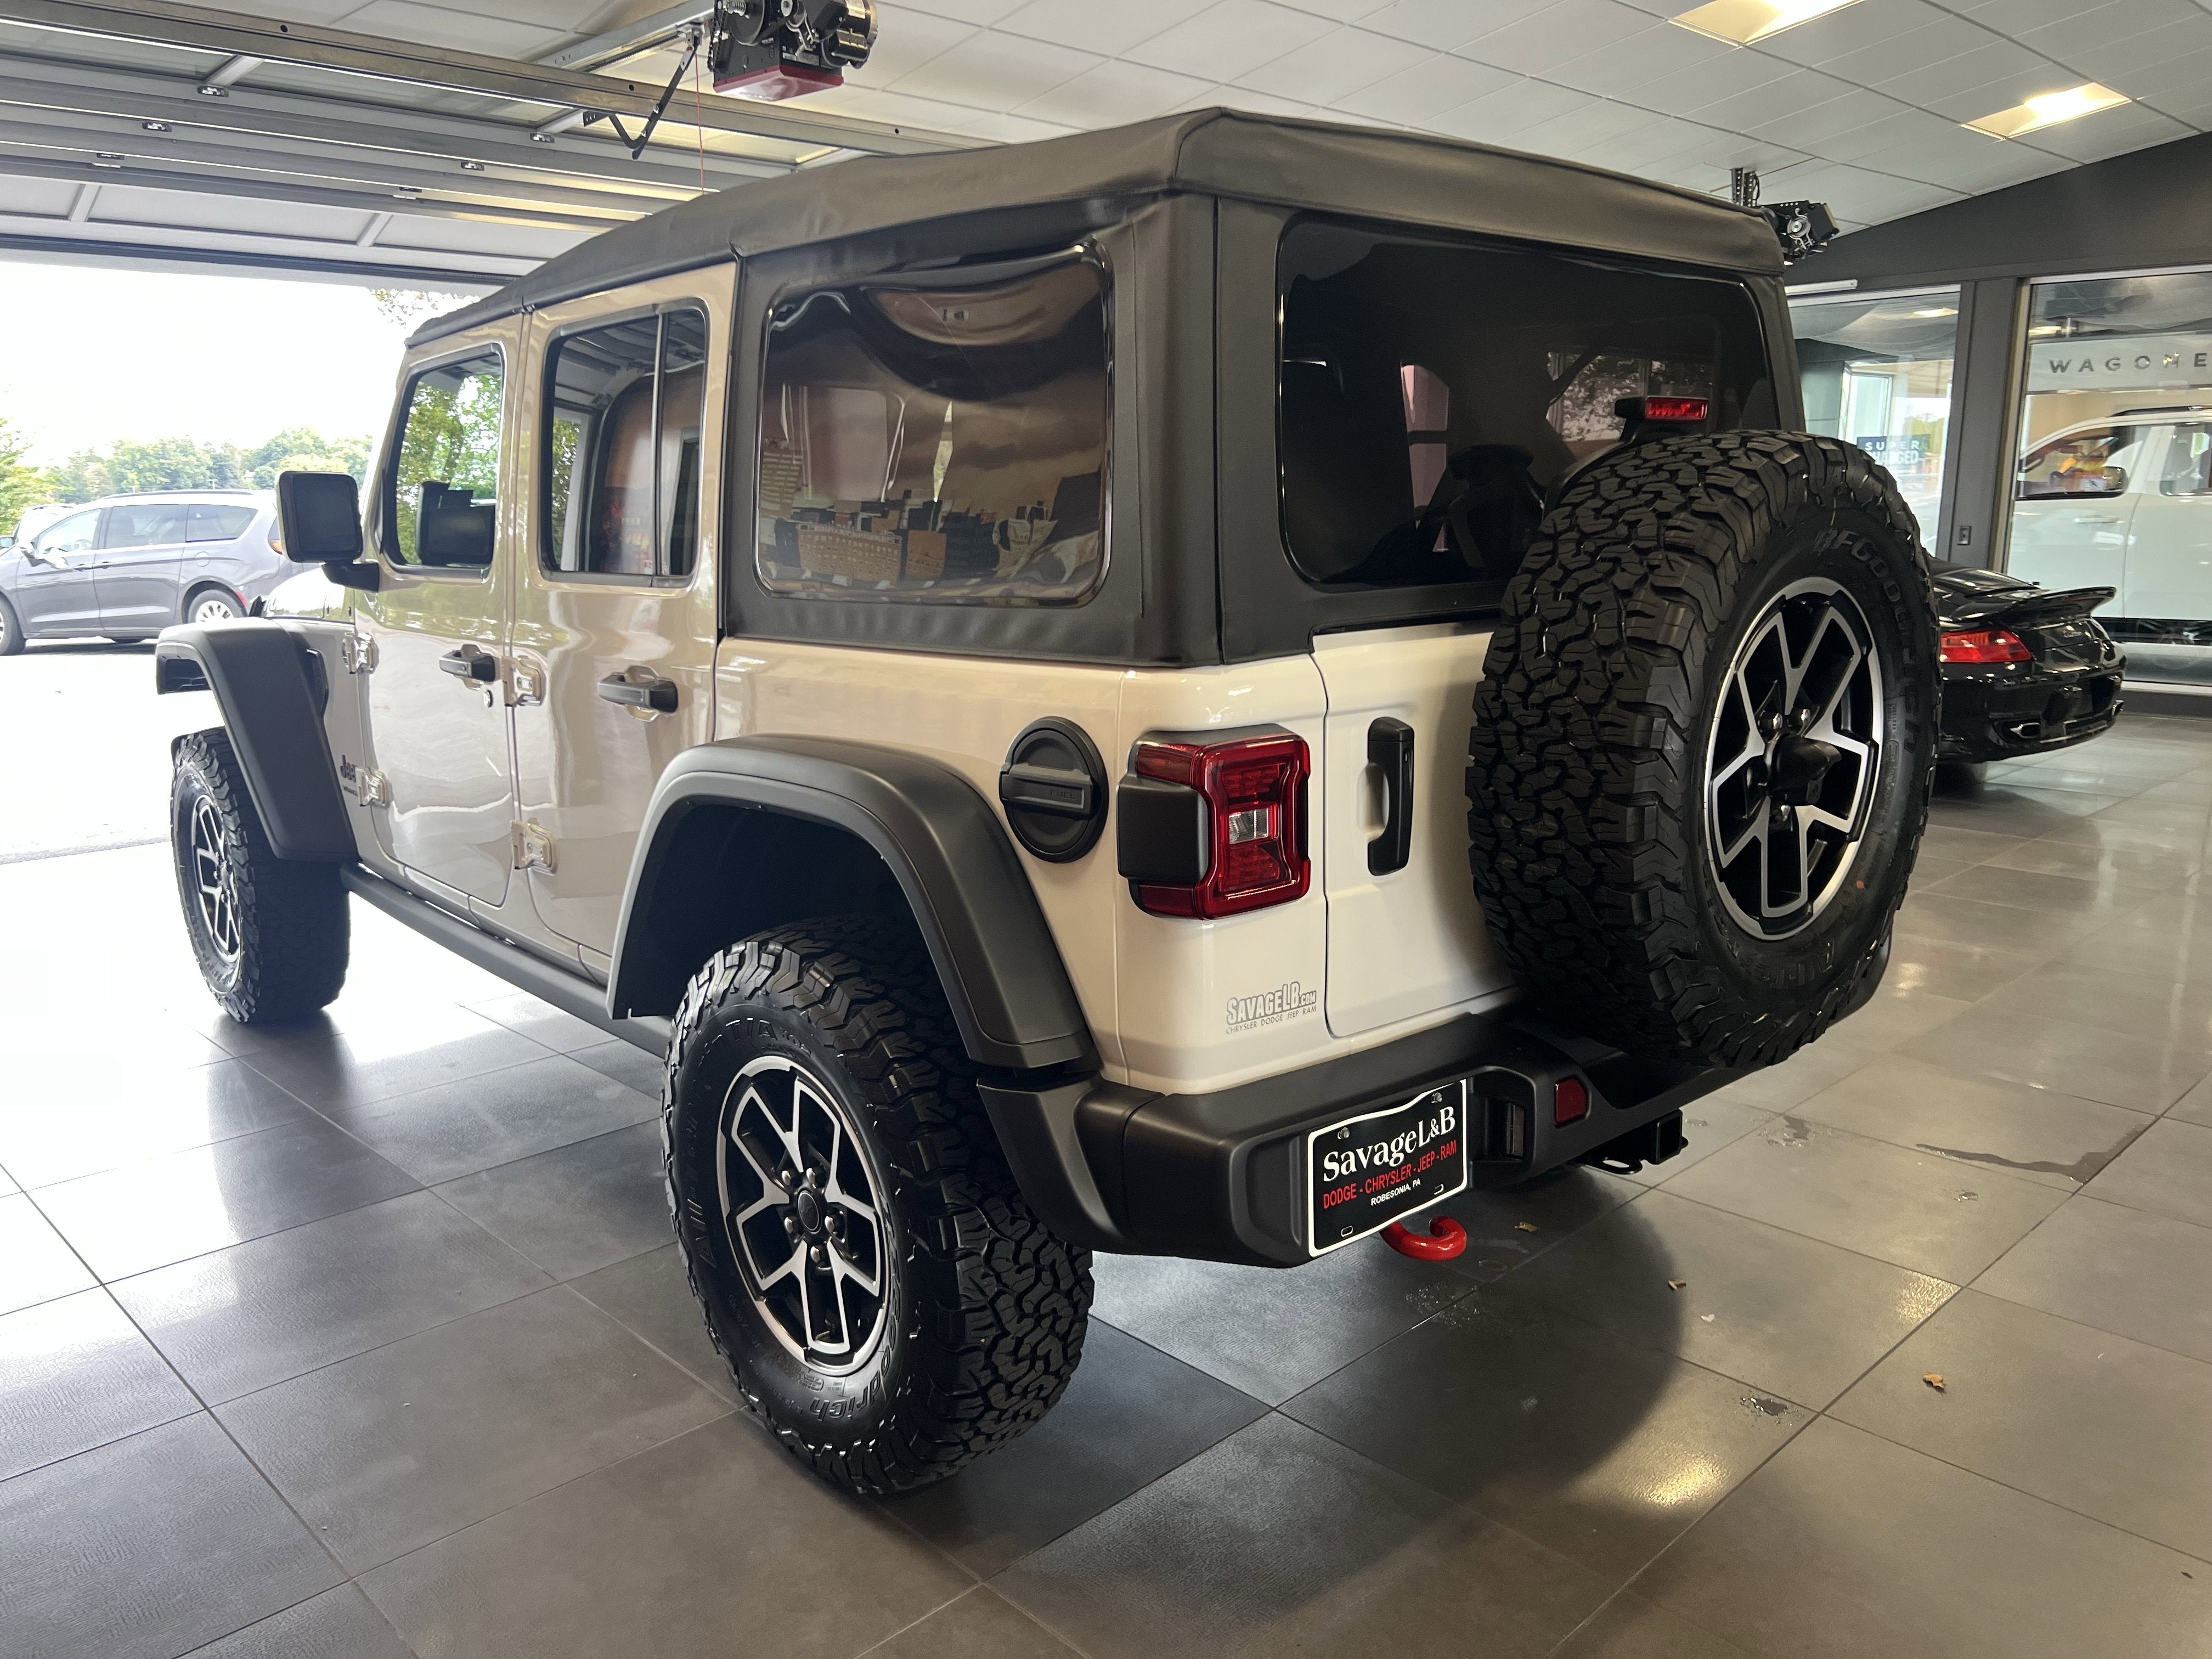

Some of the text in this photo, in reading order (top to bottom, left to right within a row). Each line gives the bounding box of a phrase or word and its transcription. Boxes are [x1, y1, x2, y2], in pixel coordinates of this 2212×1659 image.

[1865, 441, 1920, 451] SUPER
[340, 754, 357, 782] Jee
[1050, 790, 1076, 800] FUEL
[1226, 1005, 1317, 1035] CHRYSLER DODGE JEEP RAM
[1323, 1183, 1357, 1209] DODGE
[1365, 1163, 1412, 1195] CHRYSLER
[1418, 1154, 1435, 1173] JEEP
[1441, 1140, 1457, 1161] RAM
[1370, 1178, 1421, 1206] ROBESONIA, PA
